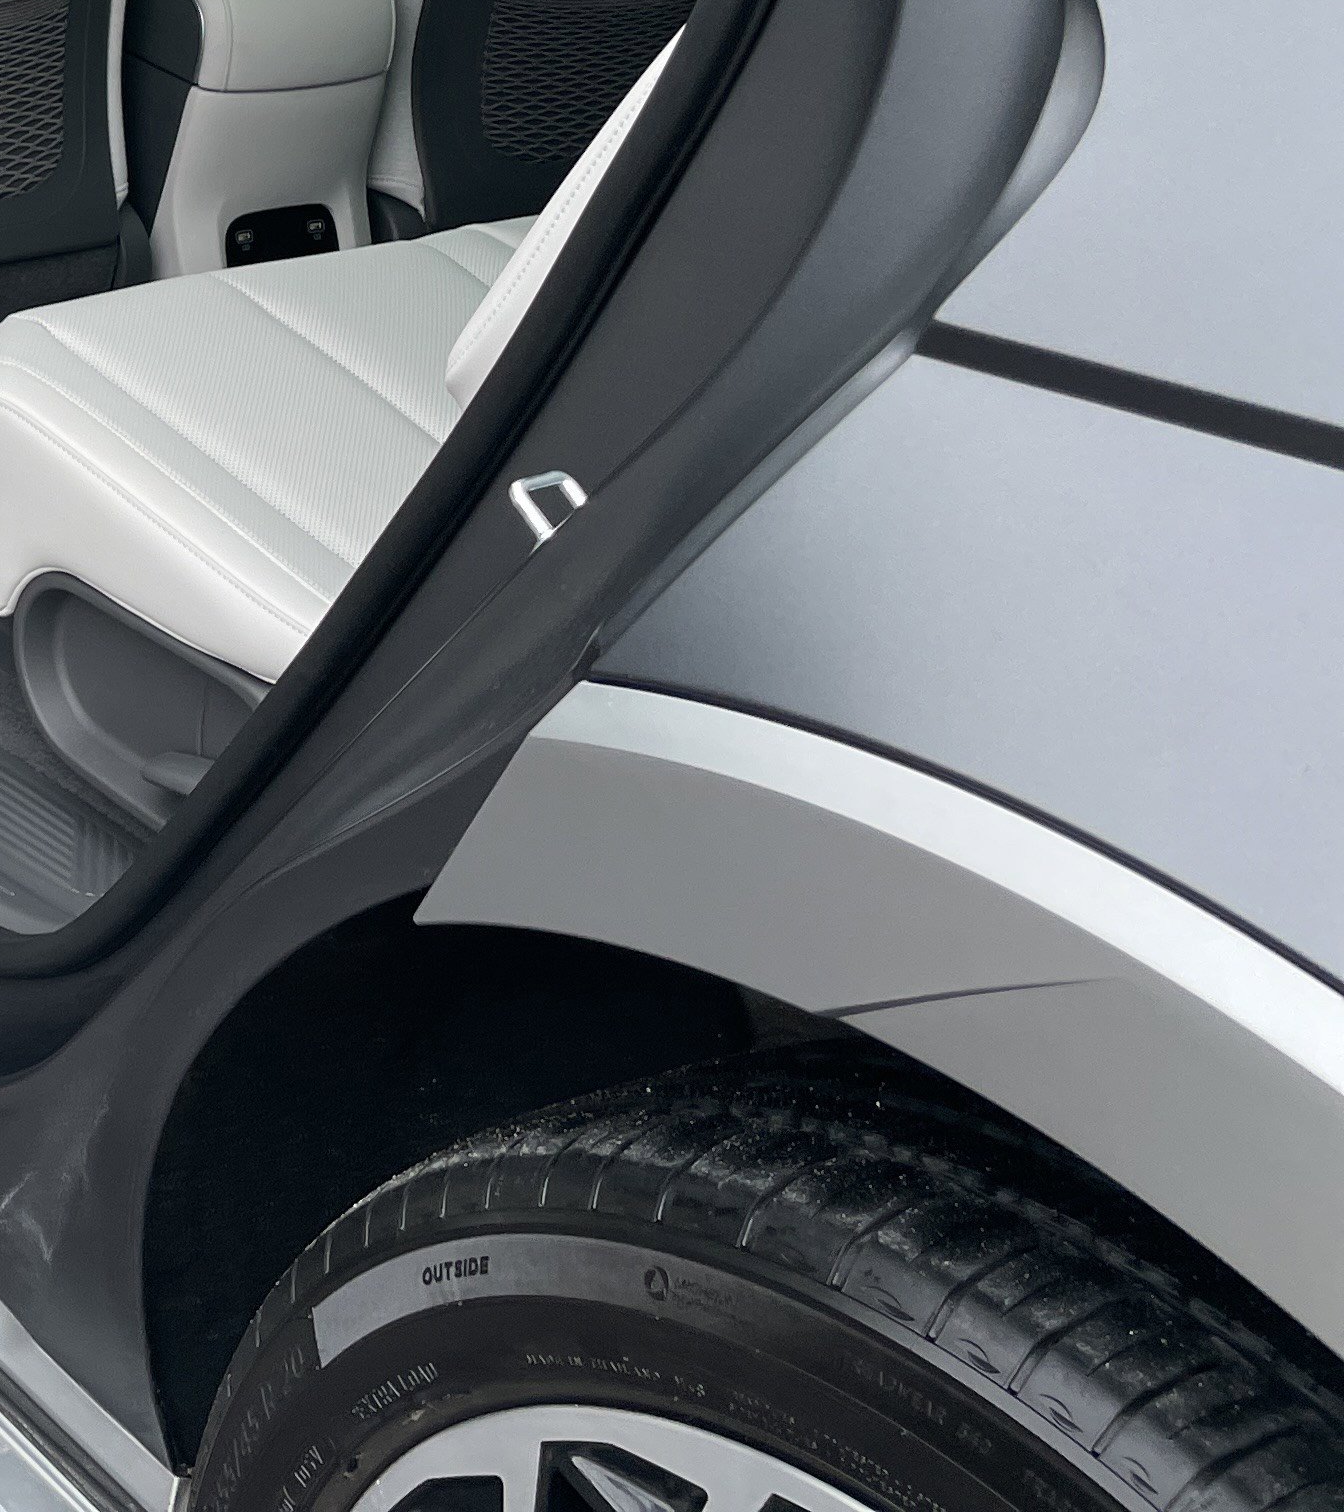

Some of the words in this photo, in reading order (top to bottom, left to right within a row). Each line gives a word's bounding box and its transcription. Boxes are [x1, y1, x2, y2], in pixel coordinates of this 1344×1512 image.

[422, 1256, 490, 1285] OUTSIDE
[352, 1380, 401, 1419] EXTRA
[397, 1362, 439, 1392] LOAD
